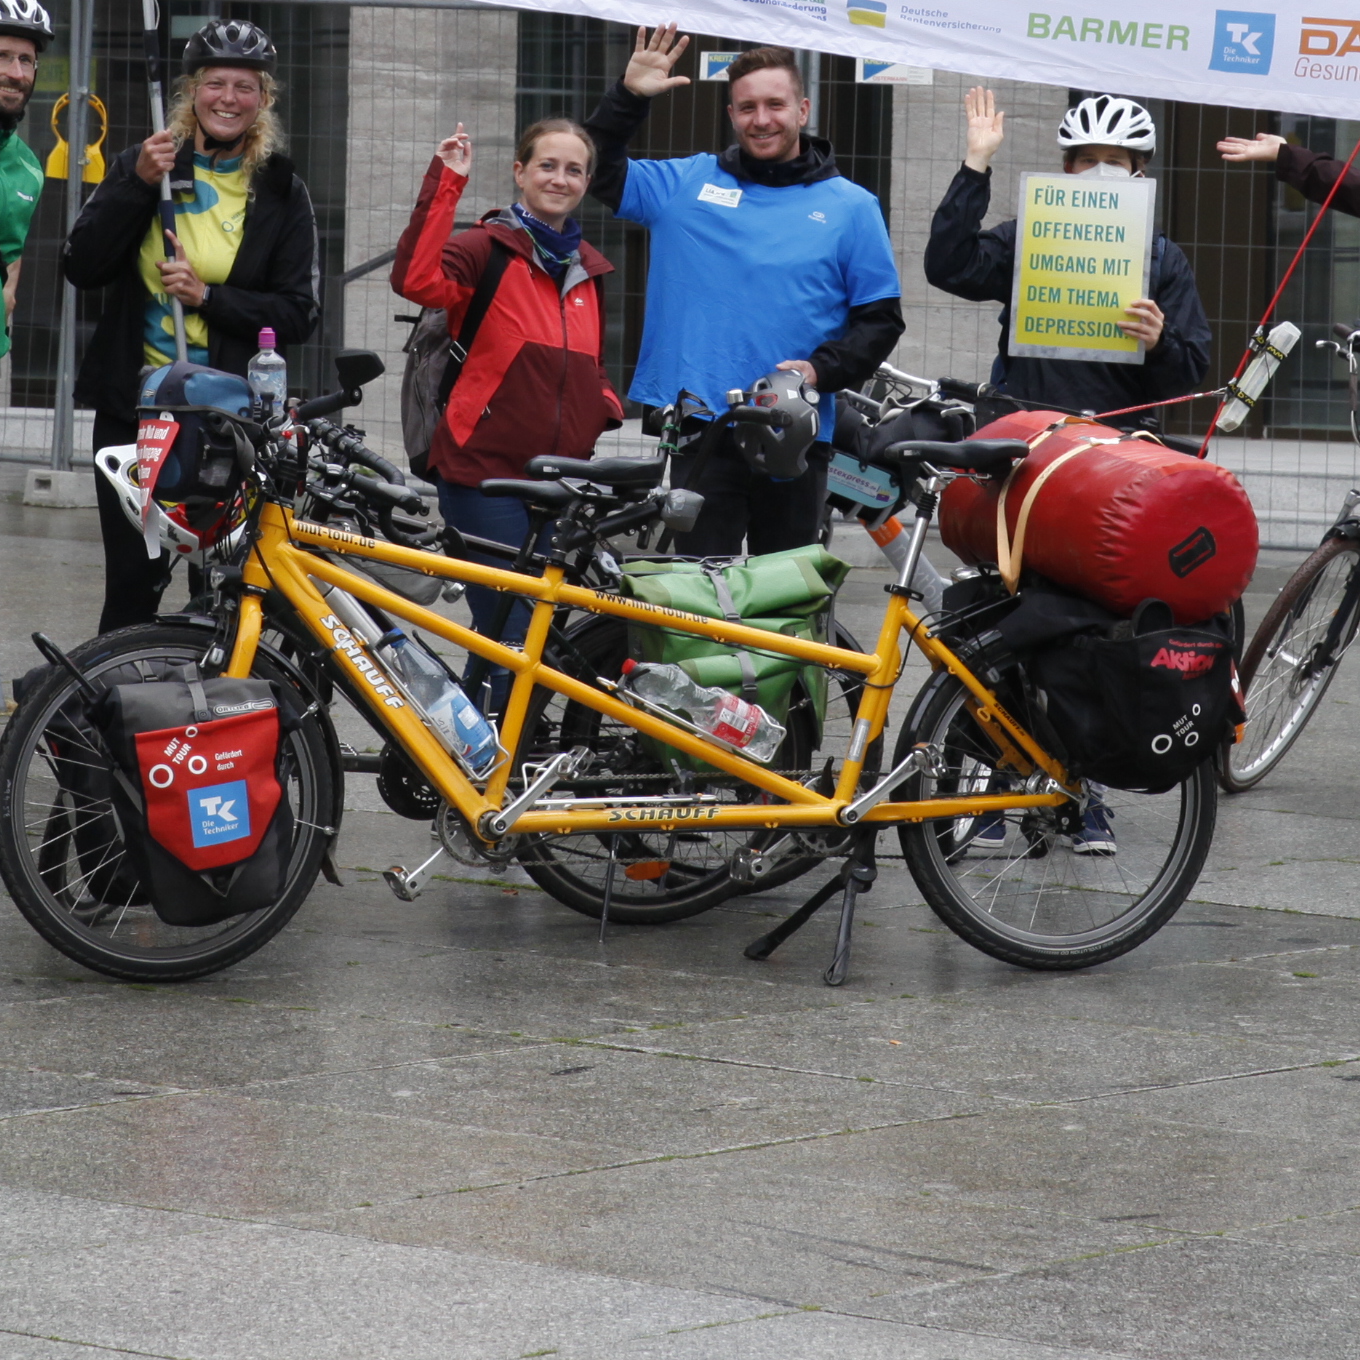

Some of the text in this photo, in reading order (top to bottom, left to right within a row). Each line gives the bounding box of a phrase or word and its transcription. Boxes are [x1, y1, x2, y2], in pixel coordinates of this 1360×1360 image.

[900, 5, 949, 18] Deutsche
[900, 14, 1001, 33] Rentenversicherung
[1027, 12, 1190, 51] BARMER
[1226, 23, 1263, 55] TK
[1223, 46, 1236, 56] Die
[1223, 54, 1260, 65] Techniker
[1034, 185, 1119, 210] FÜR EINEN
[1032, 221, 1126, 243] OFFENEREN
[1030, 253, 1131, 276] UMGANG MIT
[1027, 285, 1119, 308] DEM THEMA
[297, 520, 375, 549] mut-tour.de
[595, 591, 709, 624] www.mut-tour.de
[320, 614, 405, 709] SCHAUFF
[1150, 647, 1216, 672] Aktion
[1172, 714, 1189, 730] MUT
[1175, 720, 1195, 738] TOUR
[164, 737, 180, 757] MUT
[172, 743, 192, 764] TOUR
[215, 749, 243, 761] Gefördert
[217, 762, 234, 771] durch
[200, 796, 238, 821] TK
[608, 808, 720, 822] SCHAUFF
[203, 823, 239, 835] Techniker
